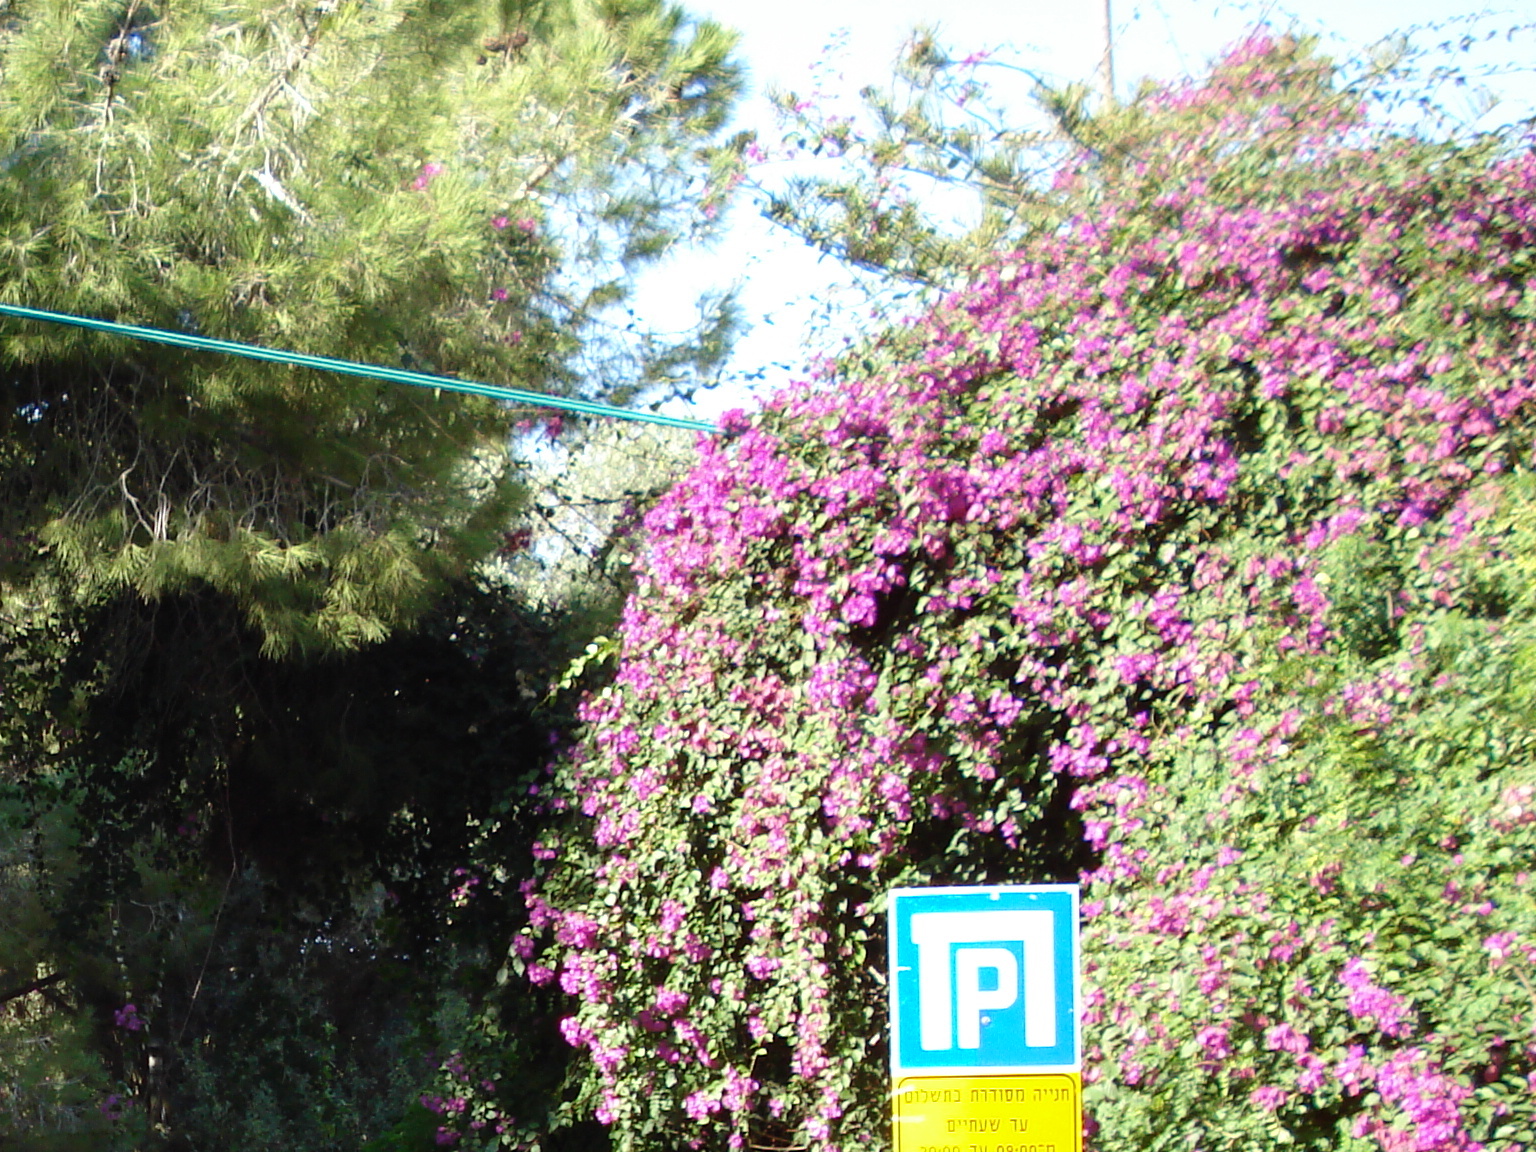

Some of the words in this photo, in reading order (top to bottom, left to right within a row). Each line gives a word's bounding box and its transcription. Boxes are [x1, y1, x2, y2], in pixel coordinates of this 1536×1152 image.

[955, 947, 1018, 1050] P
[905, 1089, 961, 1103] בתשלום
[971, 1089, 1025, 1102] מסודרת
[1033, 1089, 1070, 1101] חנייה
[947, 1119, 1000, 1133] שעתיים
[1010, 1119, 1028, 1132] עד
